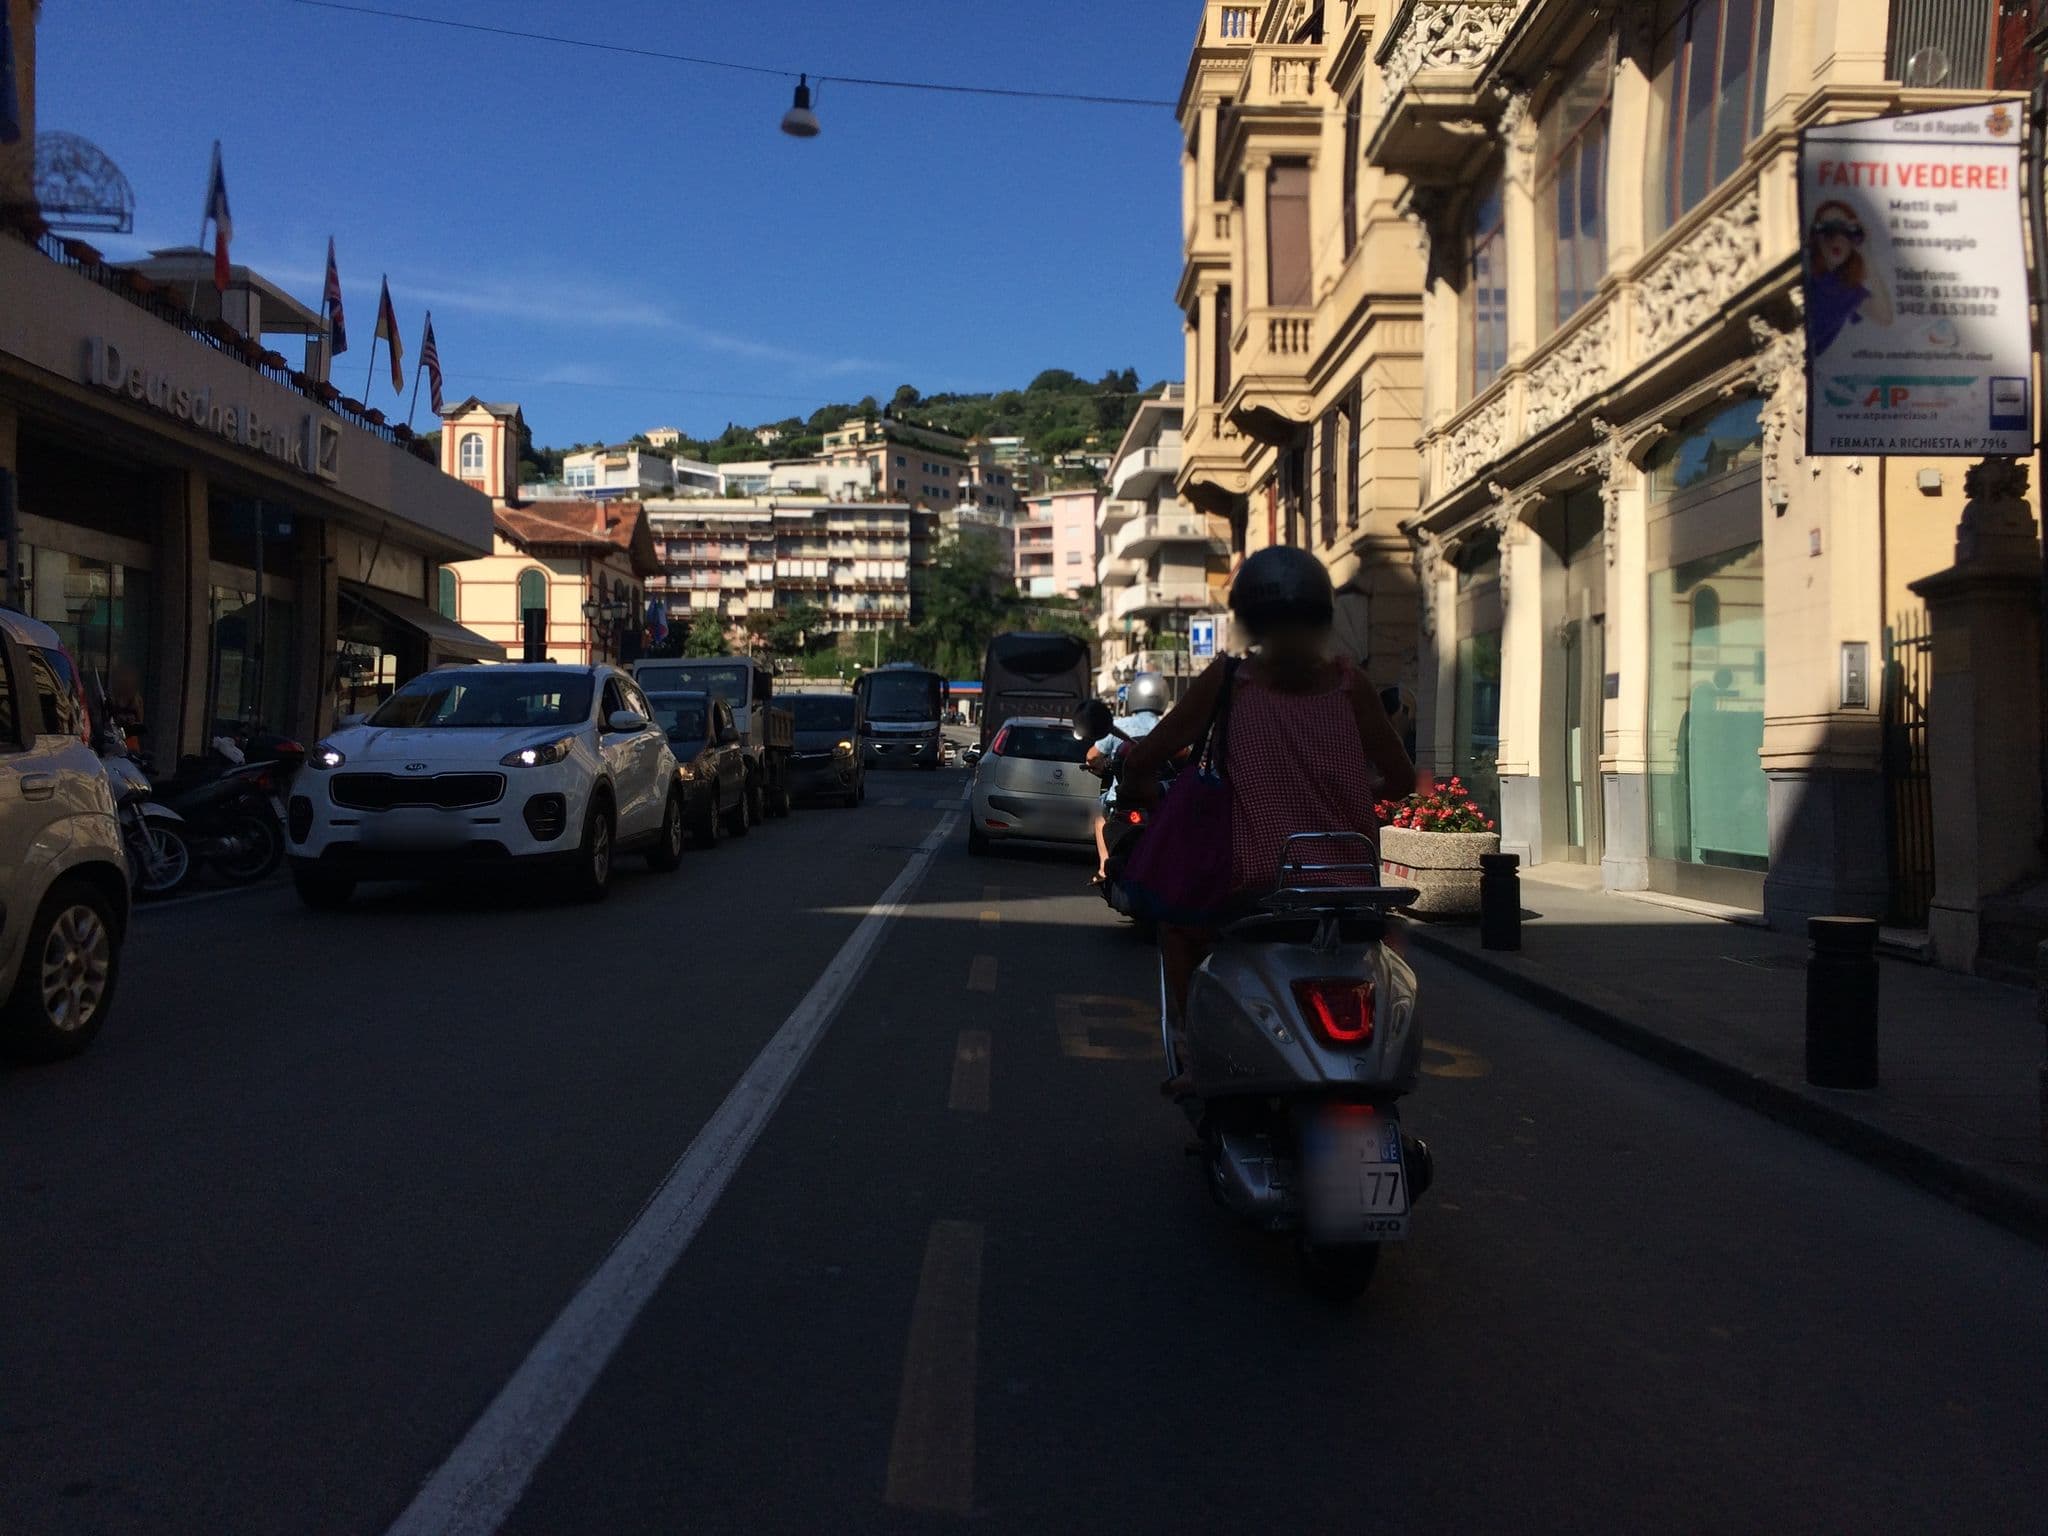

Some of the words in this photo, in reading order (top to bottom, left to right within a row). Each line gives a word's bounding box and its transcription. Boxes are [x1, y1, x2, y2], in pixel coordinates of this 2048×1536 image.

[1923, 119, 1933, 132] di
[1935, 120, 1981, 135] Rapallo
[1818, 160, 1889, 187] FATTI
[1896, 163, 2009, 189] VEDERE!
[1934, 200, 1957, 215] qui
[1903, 218, 1929, 230] tuo
[1891, 236, 1977, 251] messaggio
[88, 336, 239, 443] Deutsche
[238, 405, 309, 474] Bank
[1830, 437, 1884, 449] FERMATA
[1888, 438, 1898, 449] A
[1901, 437, 1961, 450] RICHIESTA
